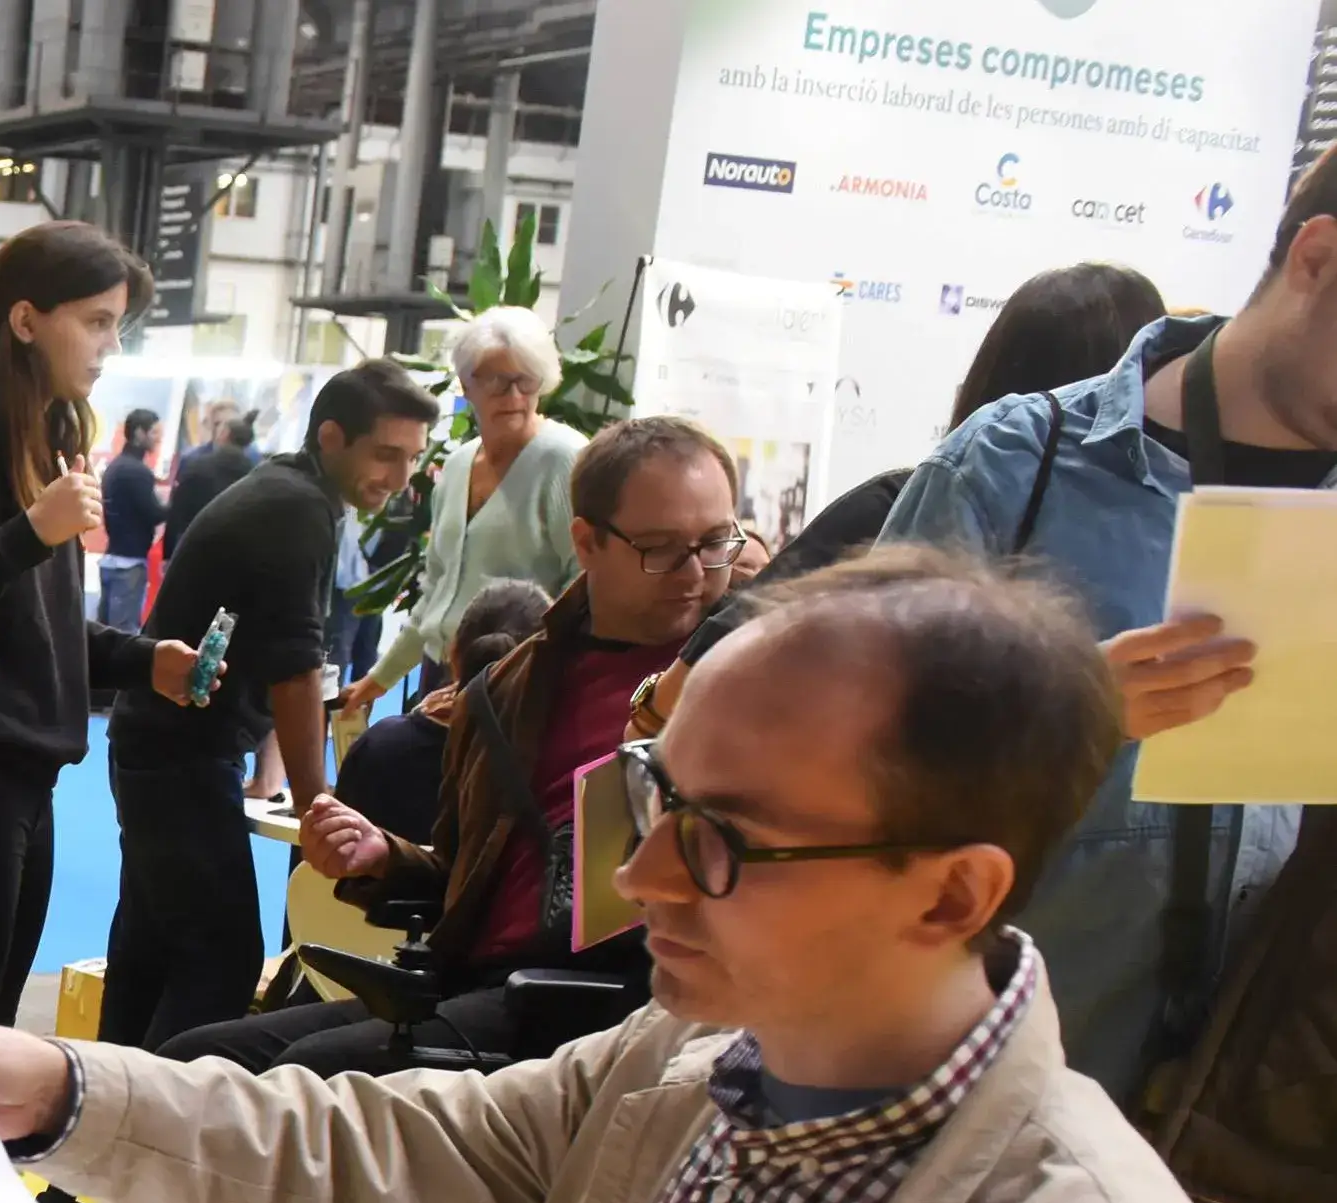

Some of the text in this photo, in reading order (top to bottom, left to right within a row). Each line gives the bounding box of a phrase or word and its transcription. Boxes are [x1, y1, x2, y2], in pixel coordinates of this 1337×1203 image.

[803, 11, 1207, 102] Empreses compromeses
[719, 65, 767, 90] amb
[771, 67, 789, 93] la
[794, 70, 878, 104] inserció
[883, 81, 954, 113] laboral
[958, 91, 982, 117] de
[986, 94, 1013, 120] les
[1017, 104, 1103, 132] persones
[1107, 114, 1148, 139] amb
[707, 157, 792, 187] Norauto
[837, 175, 928, 200] ARMONIA
[975, 183, 1032, 210] Costa
[1114, 202, 1147, 224] cet
[859, 281, 903, 302] CARES
